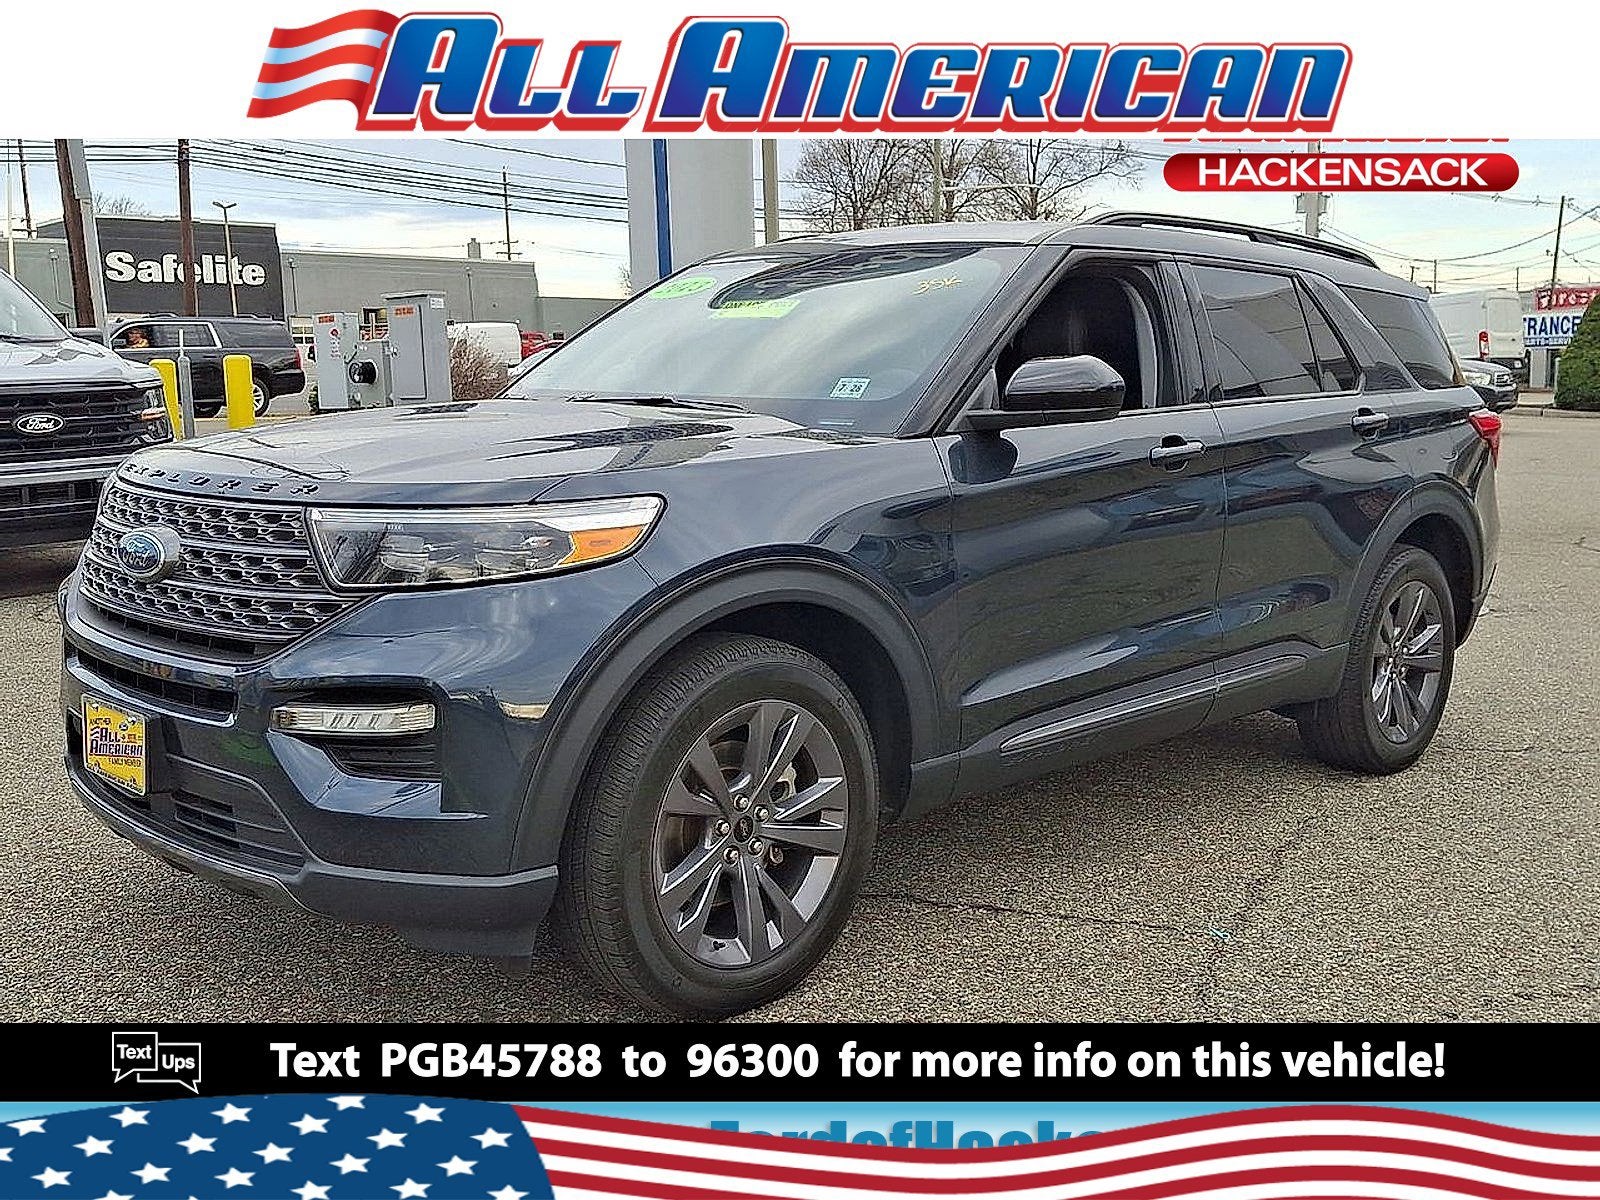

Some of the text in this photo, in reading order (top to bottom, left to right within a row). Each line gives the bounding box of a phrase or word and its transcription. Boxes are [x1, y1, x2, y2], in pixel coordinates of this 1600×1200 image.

[104, 250, 267, 287] Safelite
[1523, 315, 1583, 336] RANCE
[26, 418, 55, 431] Ford
[124, 463, 320, 495] EXPLORER
[89, 738, 143, 756] AMERICAN
